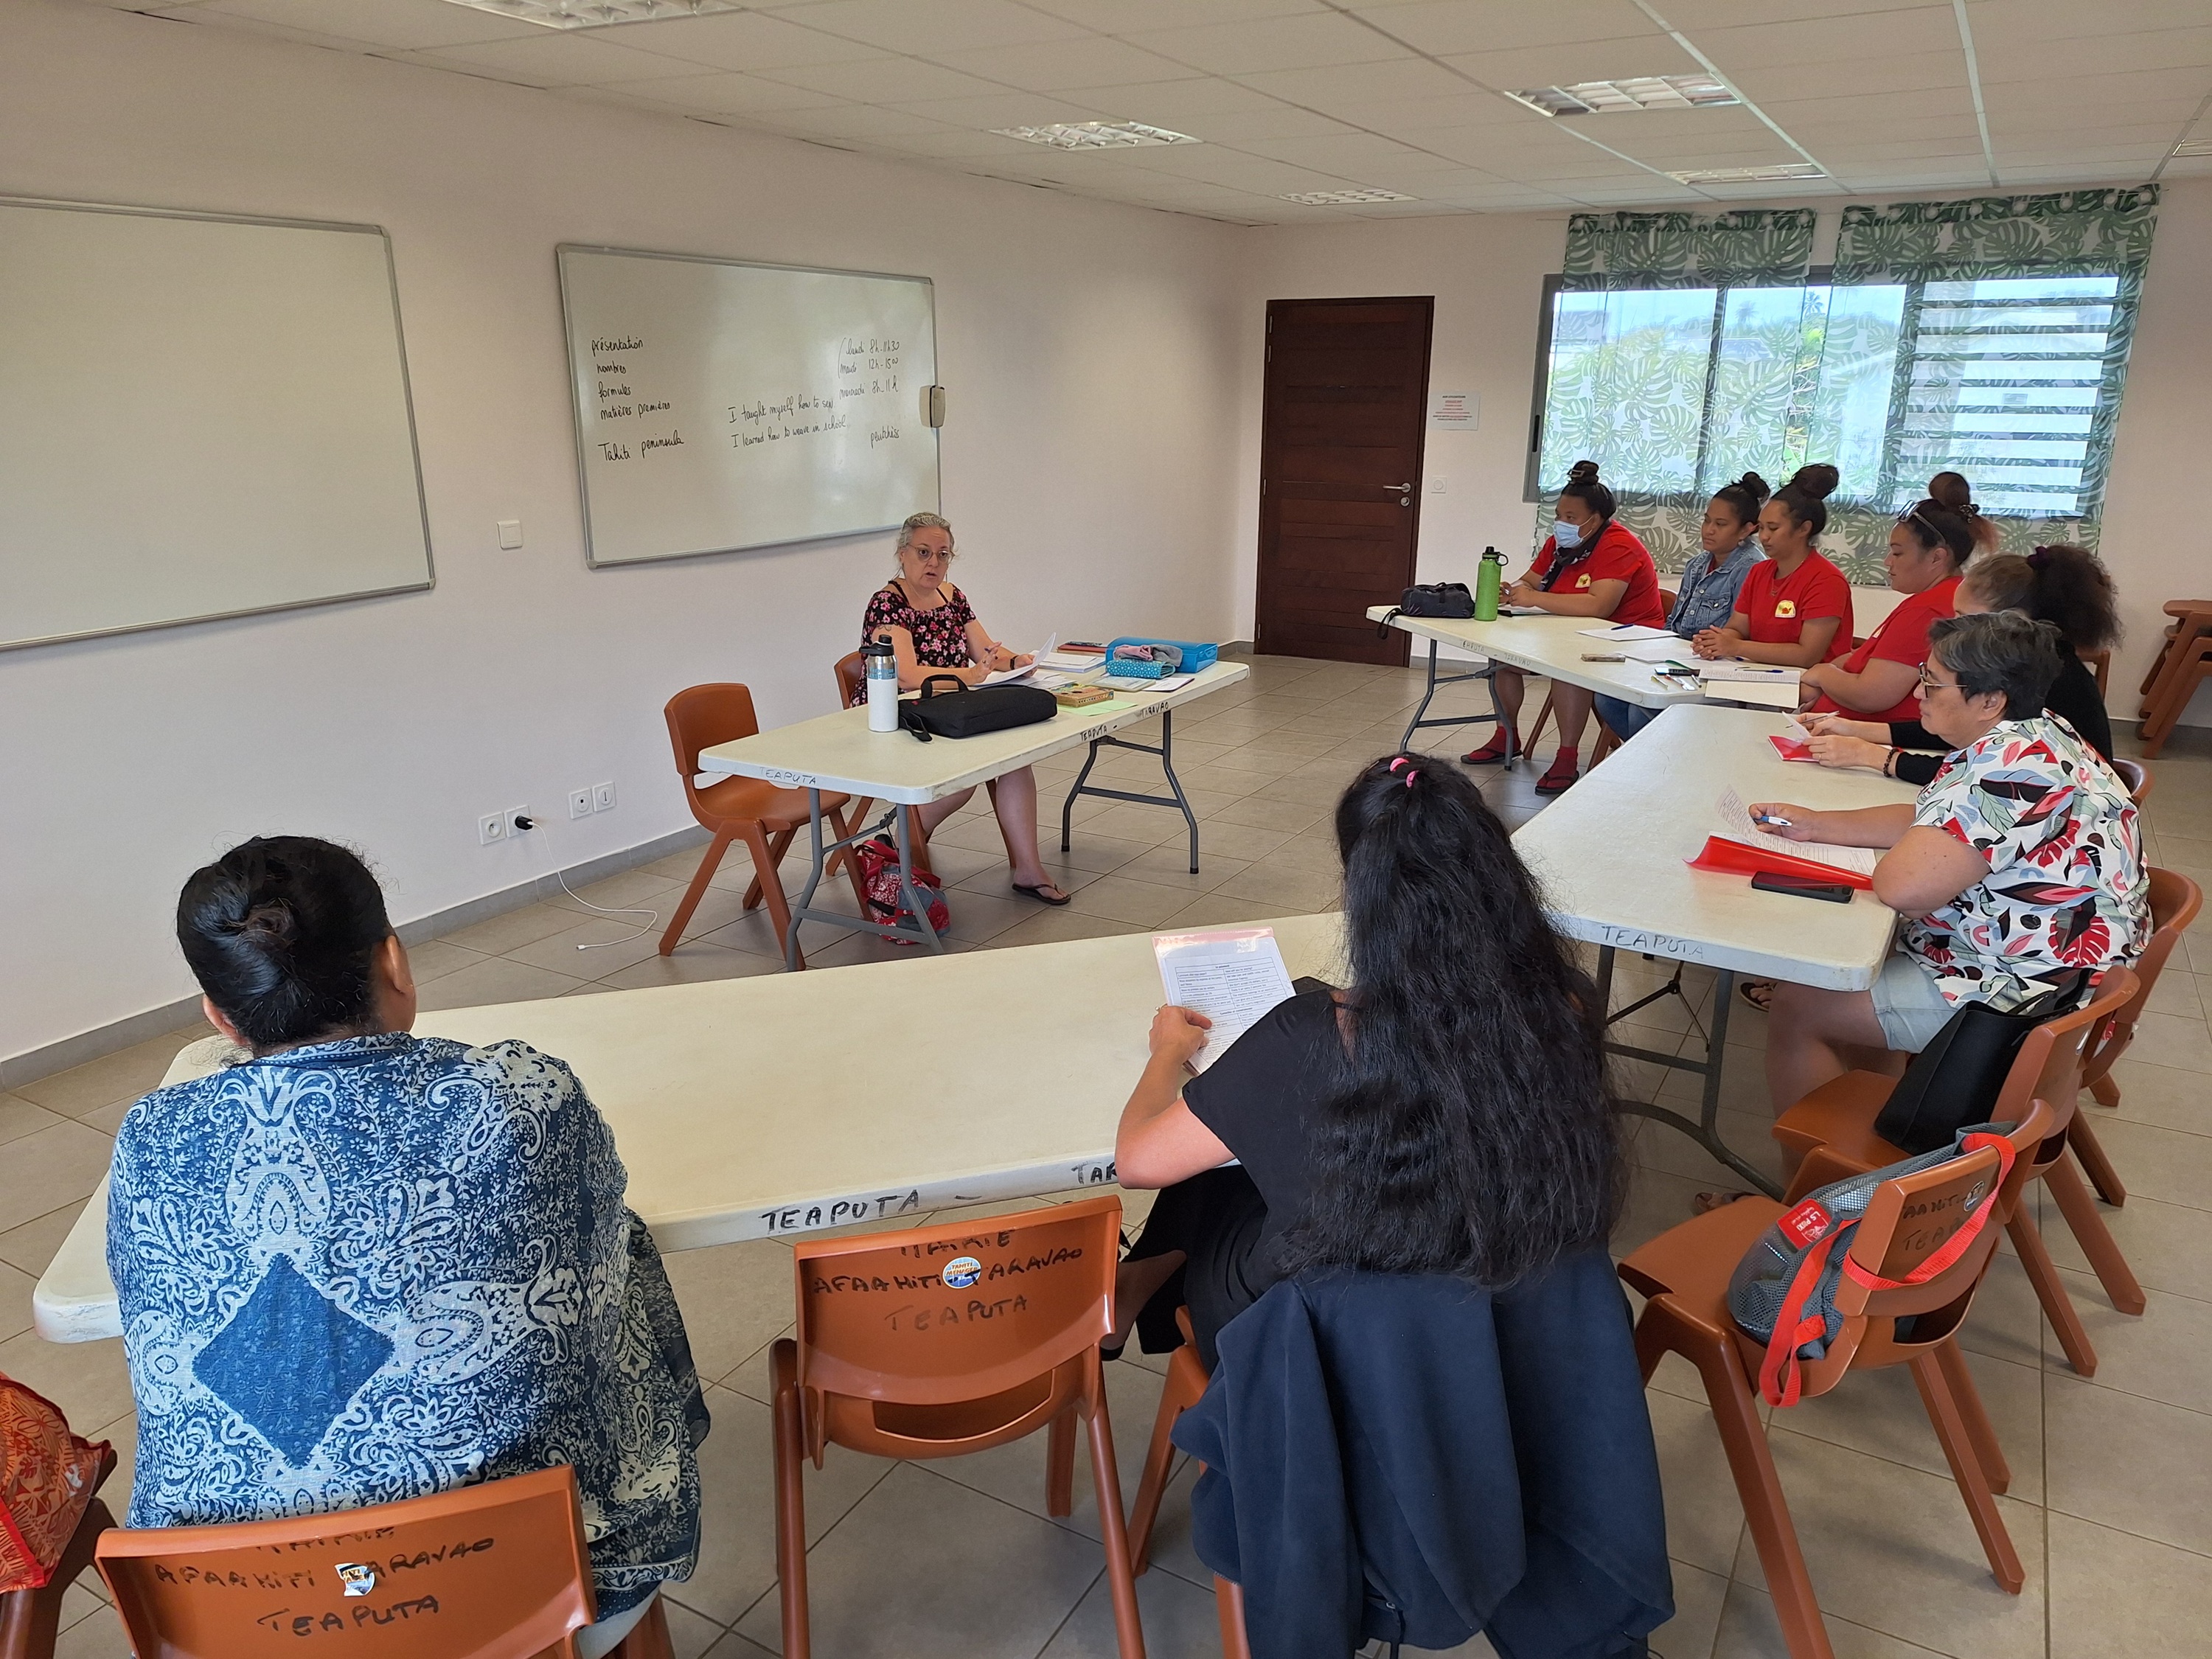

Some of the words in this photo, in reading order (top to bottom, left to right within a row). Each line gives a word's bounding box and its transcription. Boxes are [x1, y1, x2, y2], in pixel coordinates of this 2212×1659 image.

[591, 335, 643, 357] présentation
[597, 360, 626, 374] nombres
[598, 380, 631, 403] formules
[638, 400, 670, 419] premières
[728, 406, 737, 424] I
[741, 400, 767, 425] taught
[769, 395, 794, 421] myself
[798, 394, 811, 410] how
[813, 395, 820, 408] to
[597, 442, 631, 462] Tahiti
[641, 429, 685, 459] peninsula
[731, 434, 740, 448] I
[742, 432, 765, 447] learned
[768, 426, 780, 441] how
[785, 425, 790, 439] to
[793, 426, 810, 437] weave
[812, 422, 820, 433] in
[1460, 639, 1485, 654] EAPUTA
[1080, 724, 1107, 741] TEAPUTA
[1139, 700, 1169, 719] TARAVAO
[759, 766, 817, 785] TEAPUTA
[1601, 925, 1703, 959] TEAPUTA
[759, 1189, 919, 1236] TEAPUTA
[951, 1262, 973, 1270] TAHITI
[884, 1294, 1027, 1331] TEAPUTA
[257, 1594, 439, 1637] TEAPUTA
